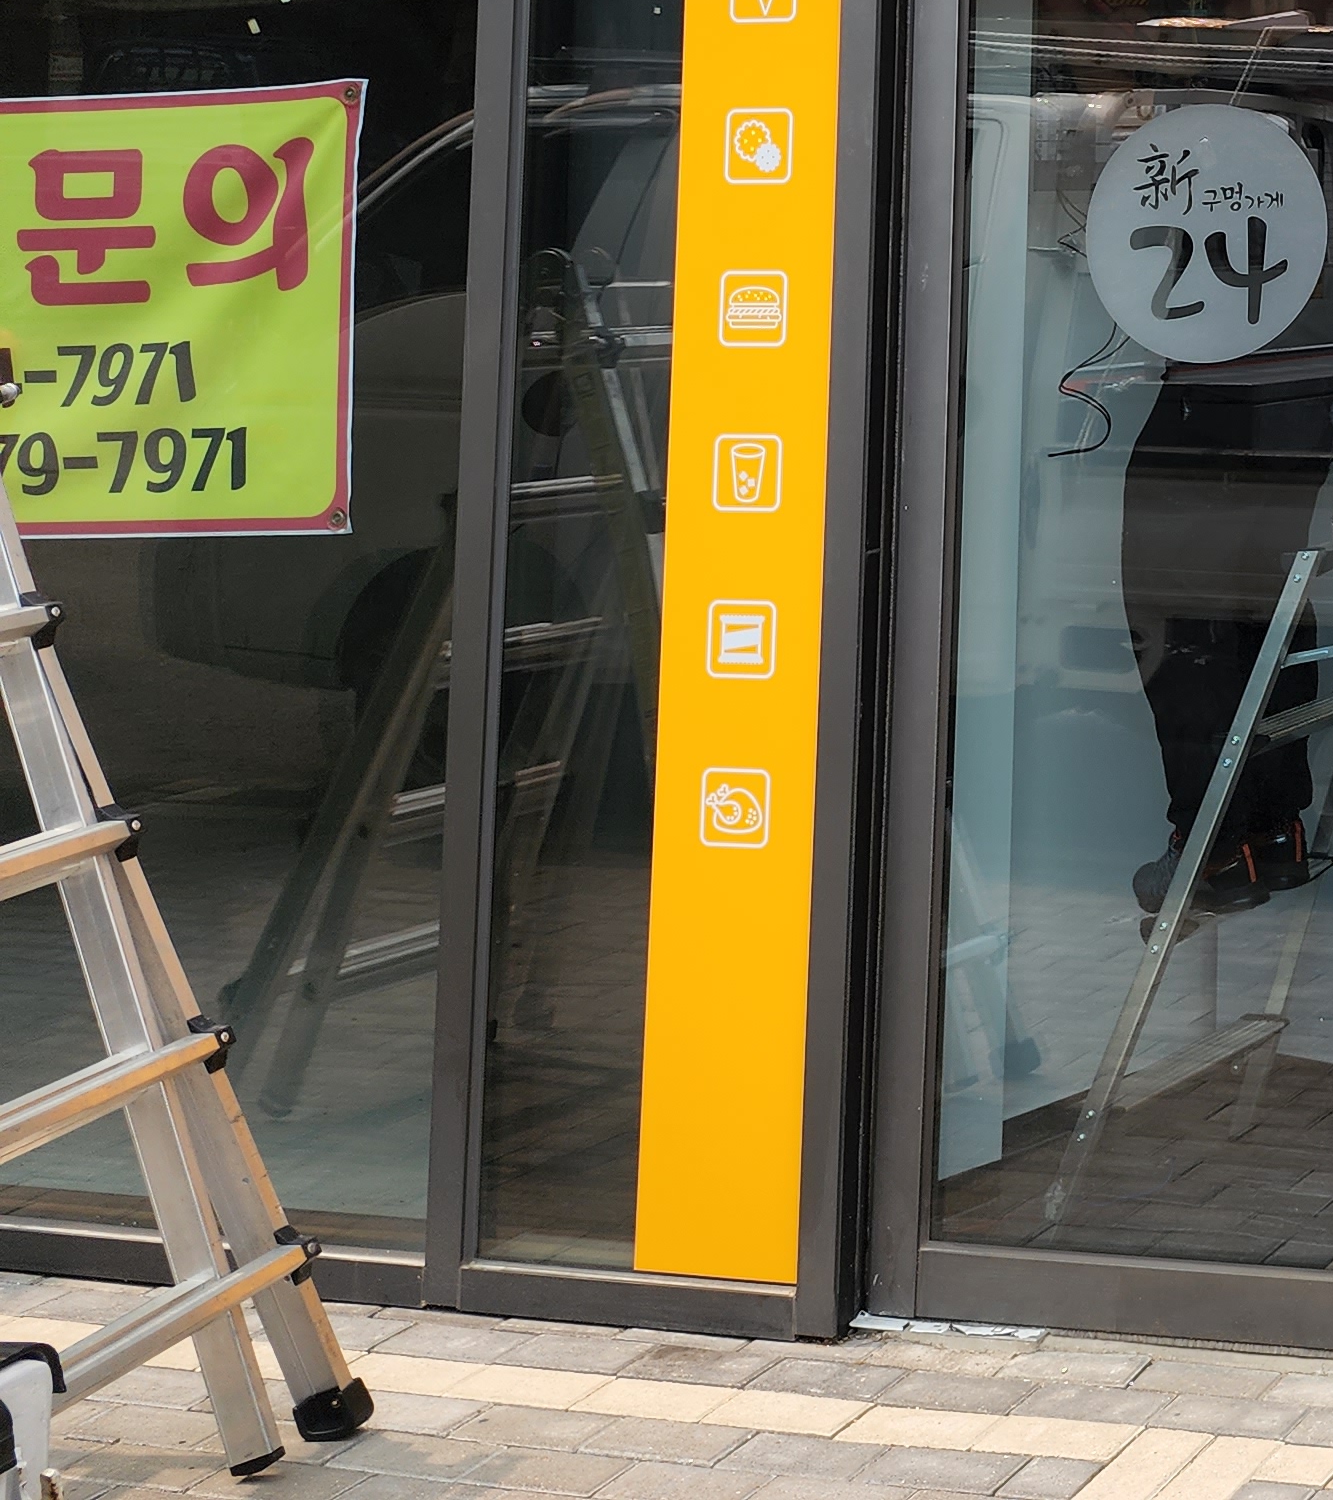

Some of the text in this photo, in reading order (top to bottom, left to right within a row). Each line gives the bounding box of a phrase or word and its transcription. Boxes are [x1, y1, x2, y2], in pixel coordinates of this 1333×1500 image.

[17, 136, 315, 306] 문의
[1133, 143, 1199, 216] 新
[1201, 182, 1285, 213] 구멍가게
[1129, 215, 1289, 326] 24
